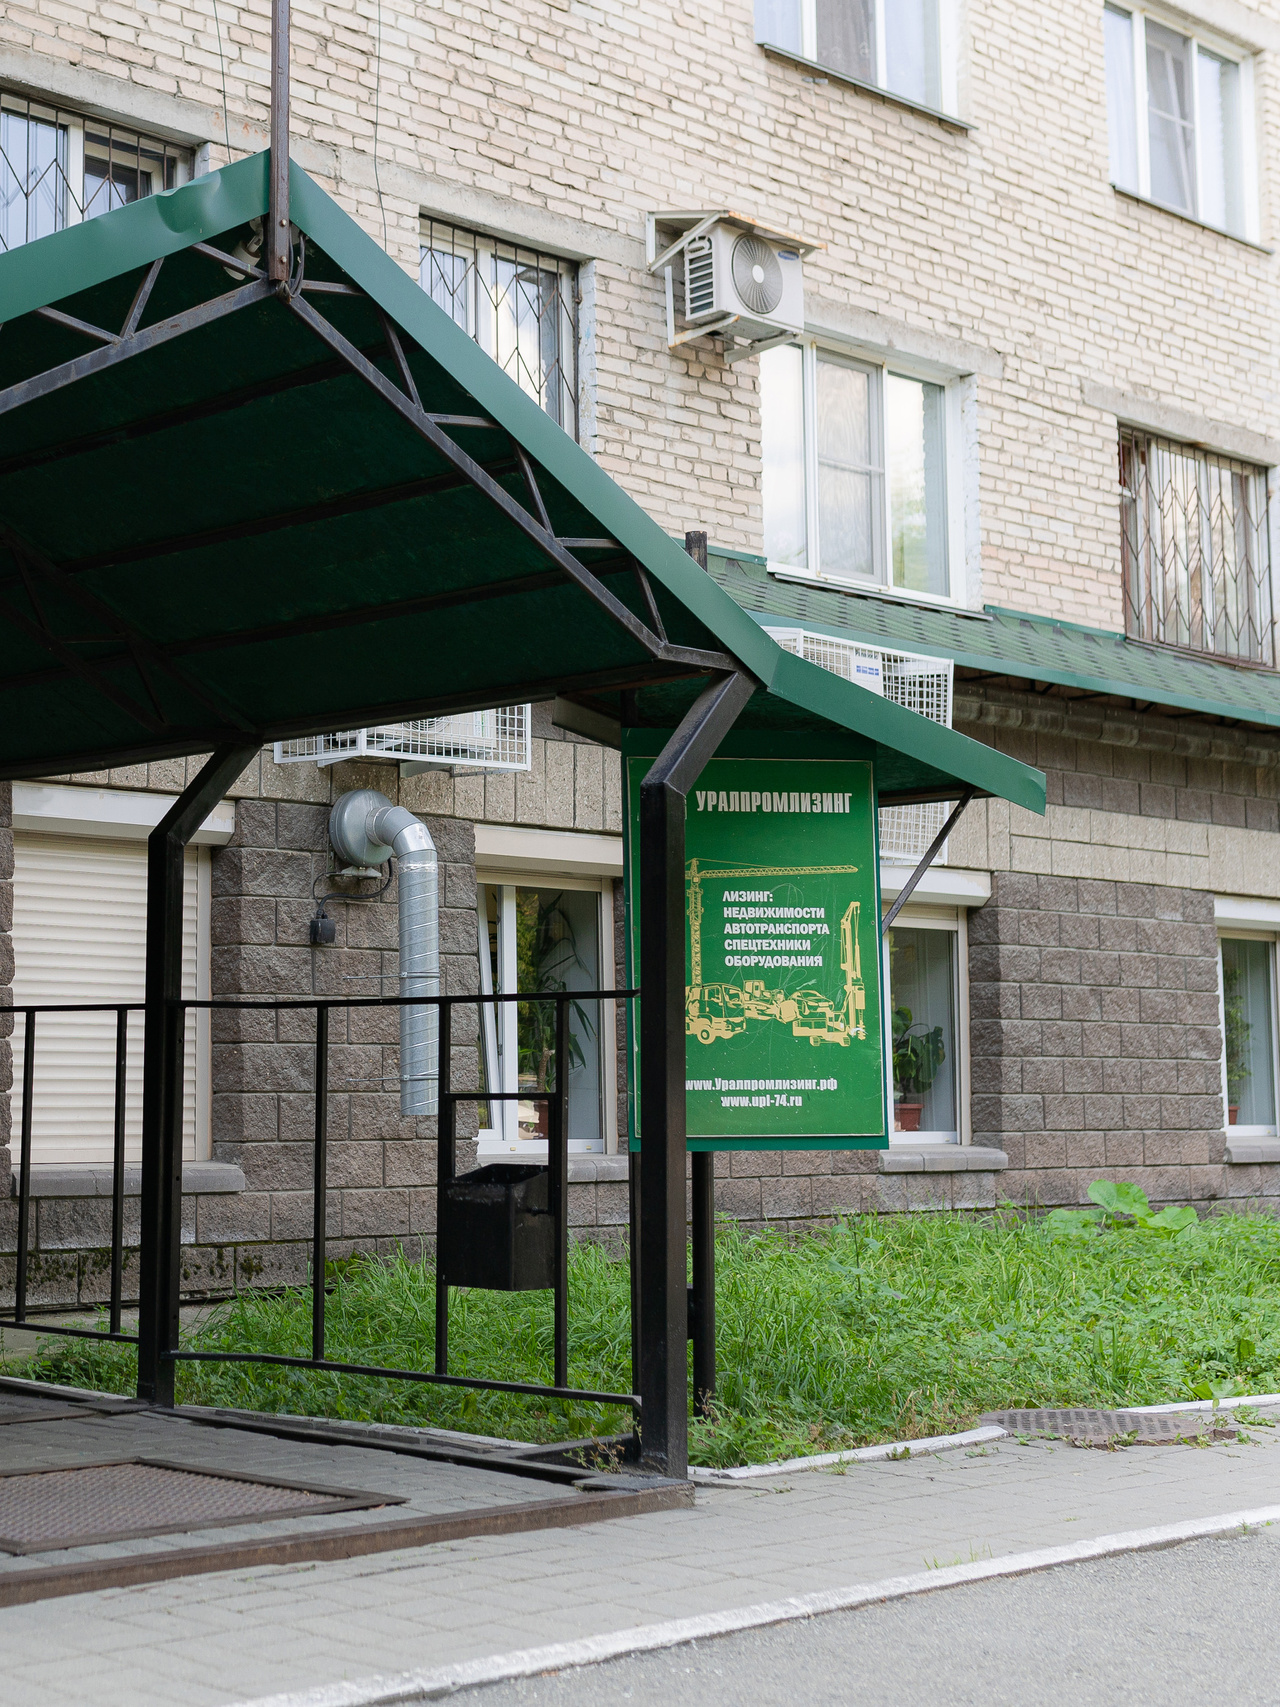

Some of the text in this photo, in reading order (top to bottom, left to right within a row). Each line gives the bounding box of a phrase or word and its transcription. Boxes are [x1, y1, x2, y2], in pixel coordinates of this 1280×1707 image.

[695, 790, 853, 814] УРАЛПРОМЛИЗИНГ
[722, 890, 774, 902] ЛИЗИНГ:
[723, 907, 825, 920] НЕДВИЖИМОСТИ
[723, 923, 830, 935] АВТОТРАНСПОРТА
[724, 939, 811, 952] СПЕЦТЕХНИКИ
[724, 955, 823, 968] ОБОРУДОВАНИЯ
[685, 1077, 838, 1092] www.Уралпромлизинг.рф
[721, 1094, 802, 1108] www.upl-74.ru
